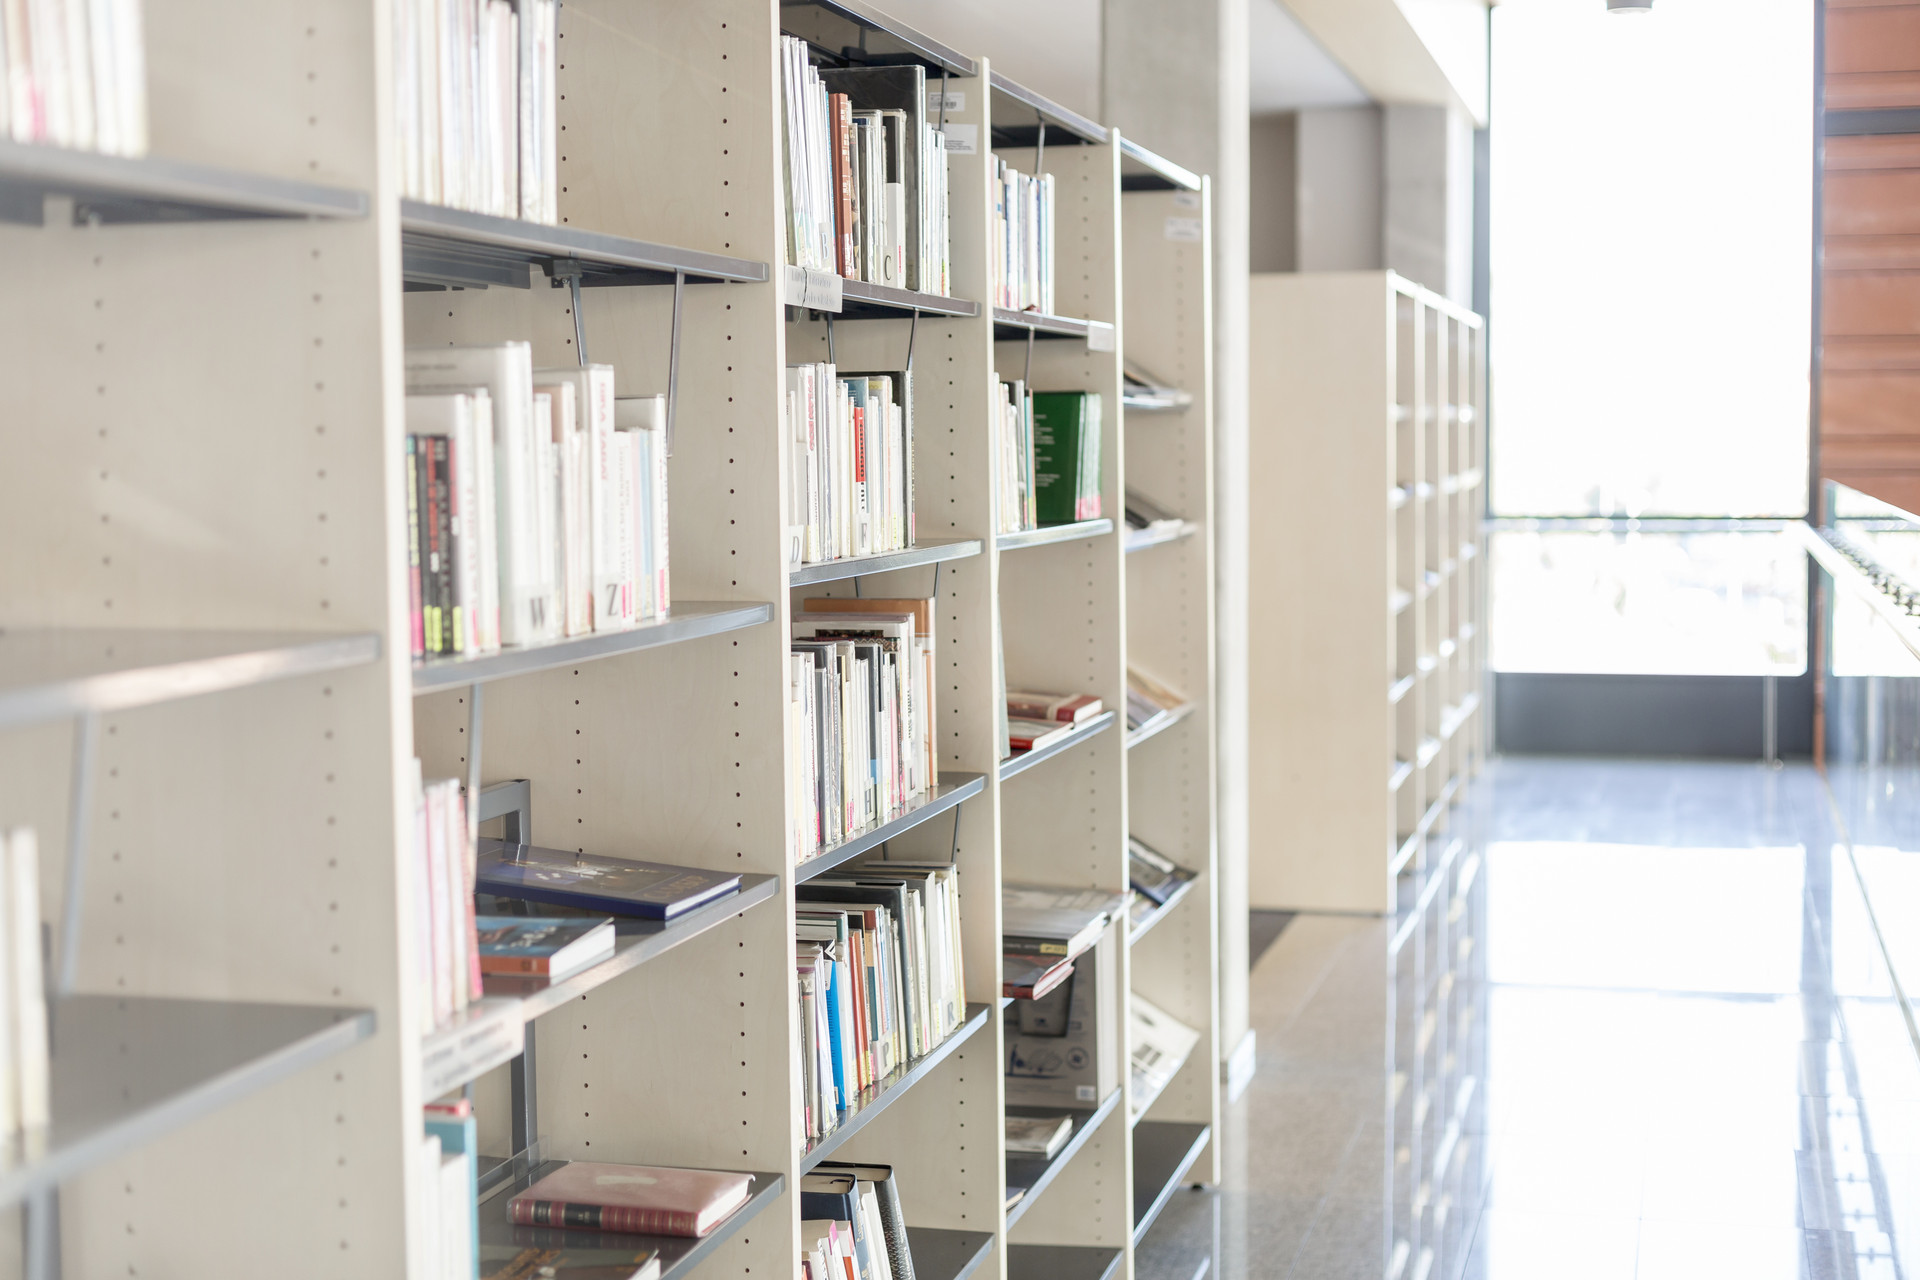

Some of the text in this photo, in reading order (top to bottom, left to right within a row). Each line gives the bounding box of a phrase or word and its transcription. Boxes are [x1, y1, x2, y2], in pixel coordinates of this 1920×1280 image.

[884, 254, 892, 281] C
[791, 535, 800, 563] D
[529, 594, 551, 630] W
[606, 583, 618, 617] Z
[909, 767, 916, 791] L
[864, 787, 872, 815] H
[947, 1001, 955, 1026] R
[882, 1041, 889, 1068] P
